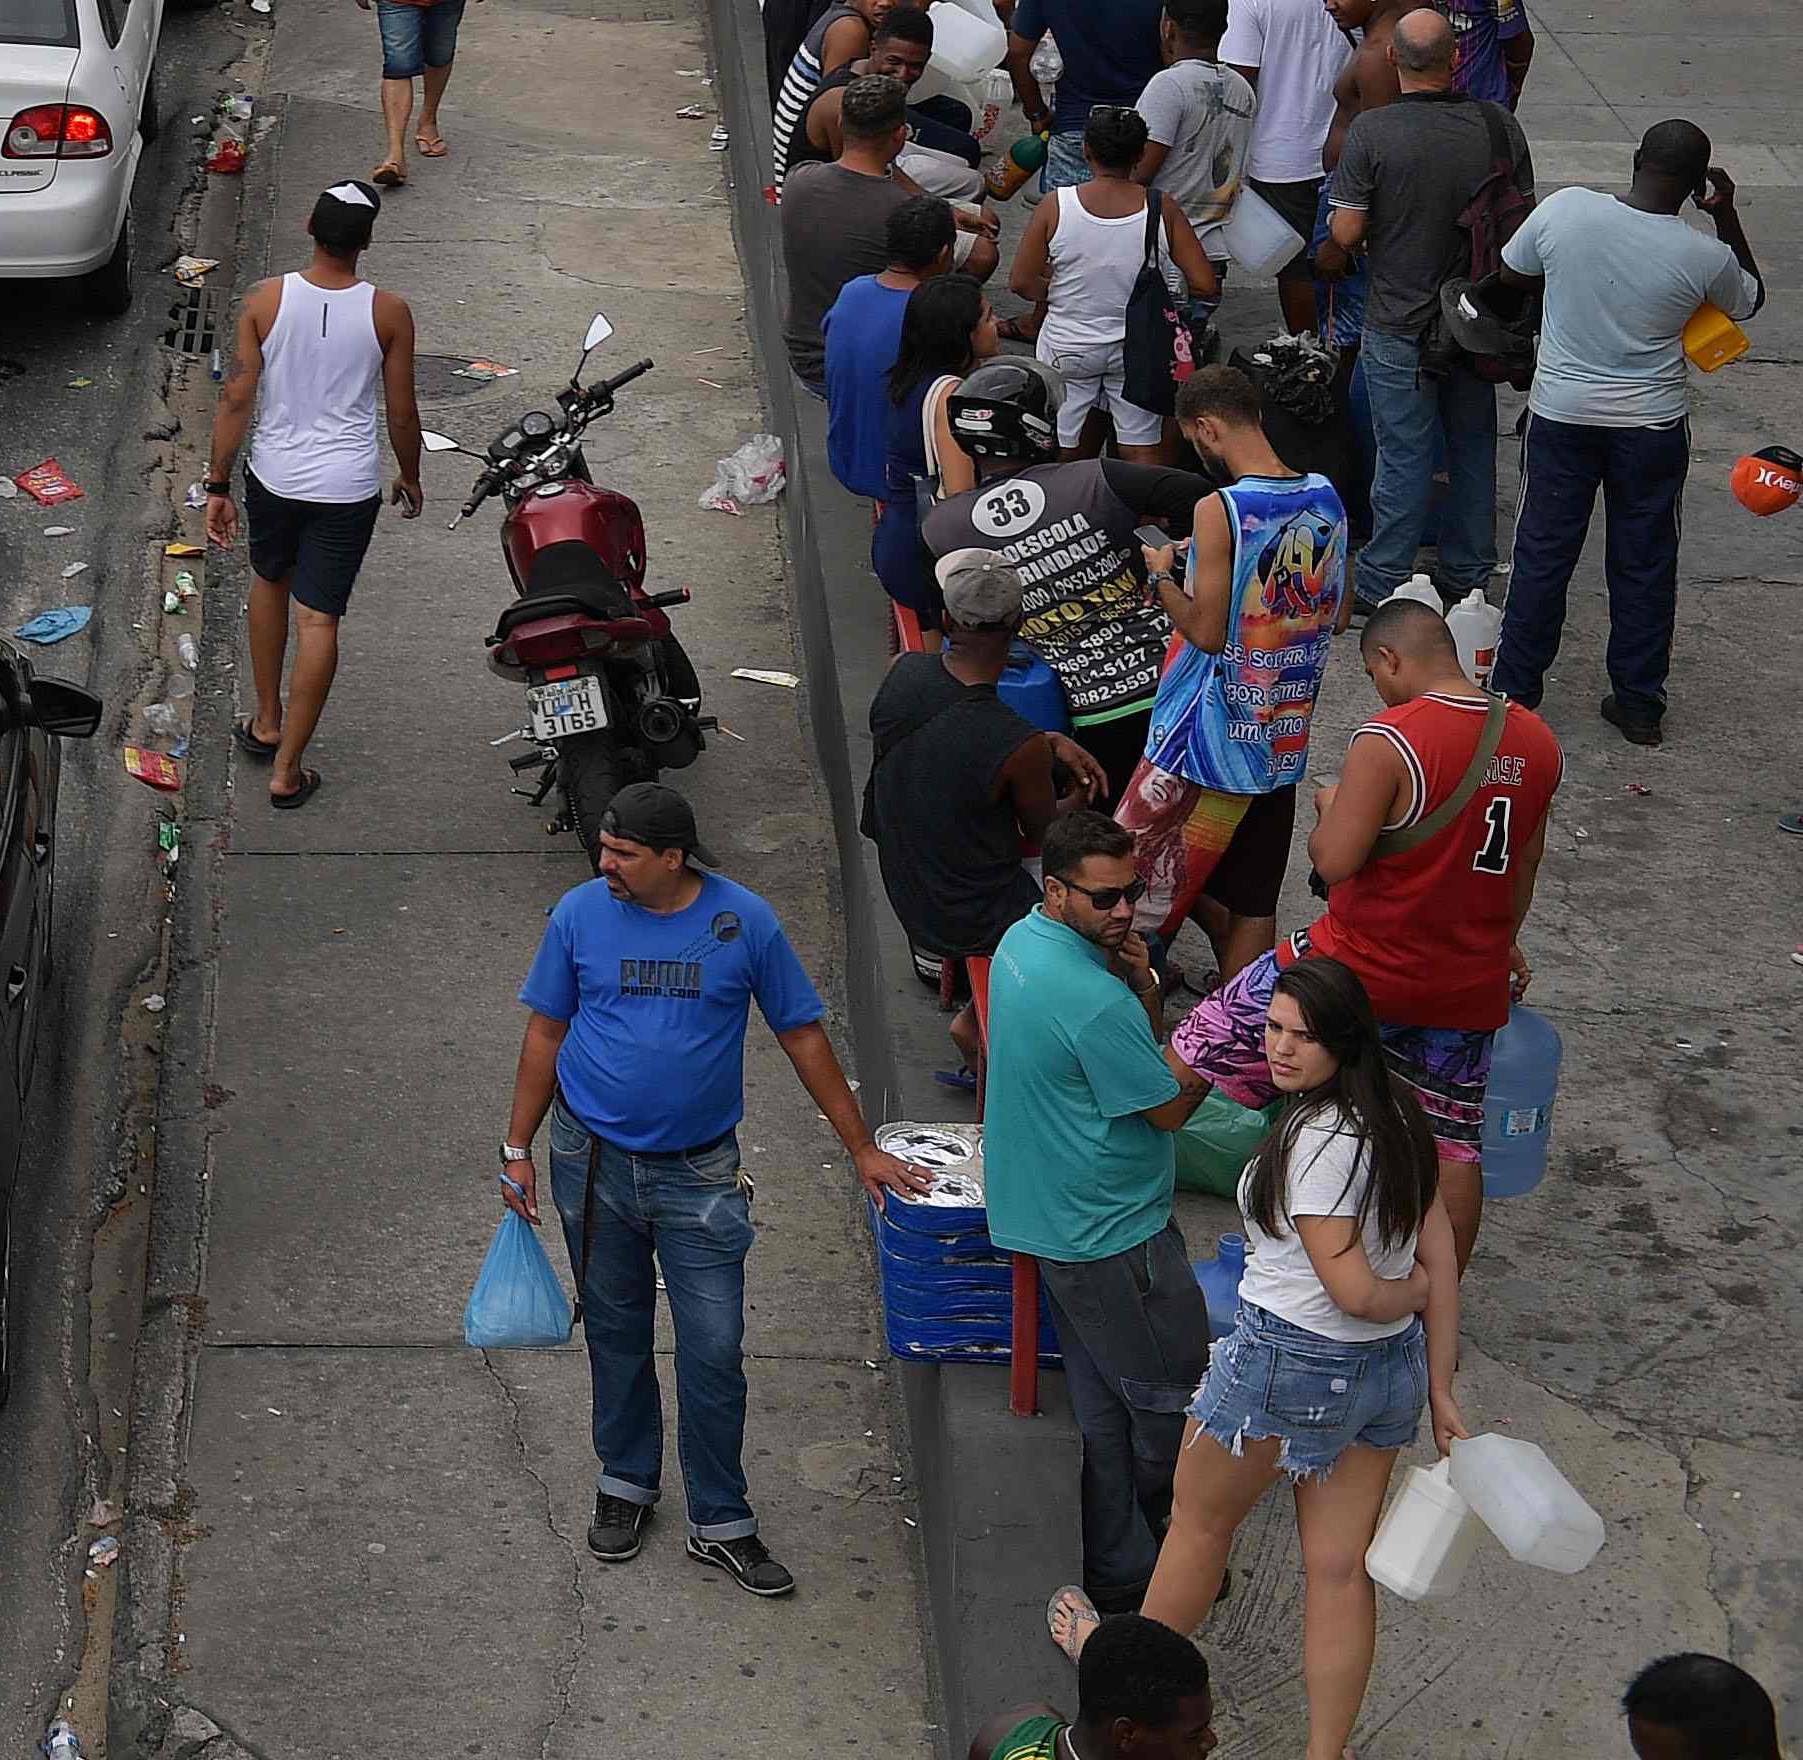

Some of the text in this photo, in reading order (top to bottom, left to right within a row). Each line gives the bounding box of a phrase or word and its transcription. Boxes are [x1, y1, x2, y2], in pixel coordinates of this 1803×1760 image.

[986, 488, 1032, 527] 33
[1016, 529, 1111, 586] RINDADE
[1472, 796, 1510, 875] 1
[619, 959, 701, 989] PUMA
